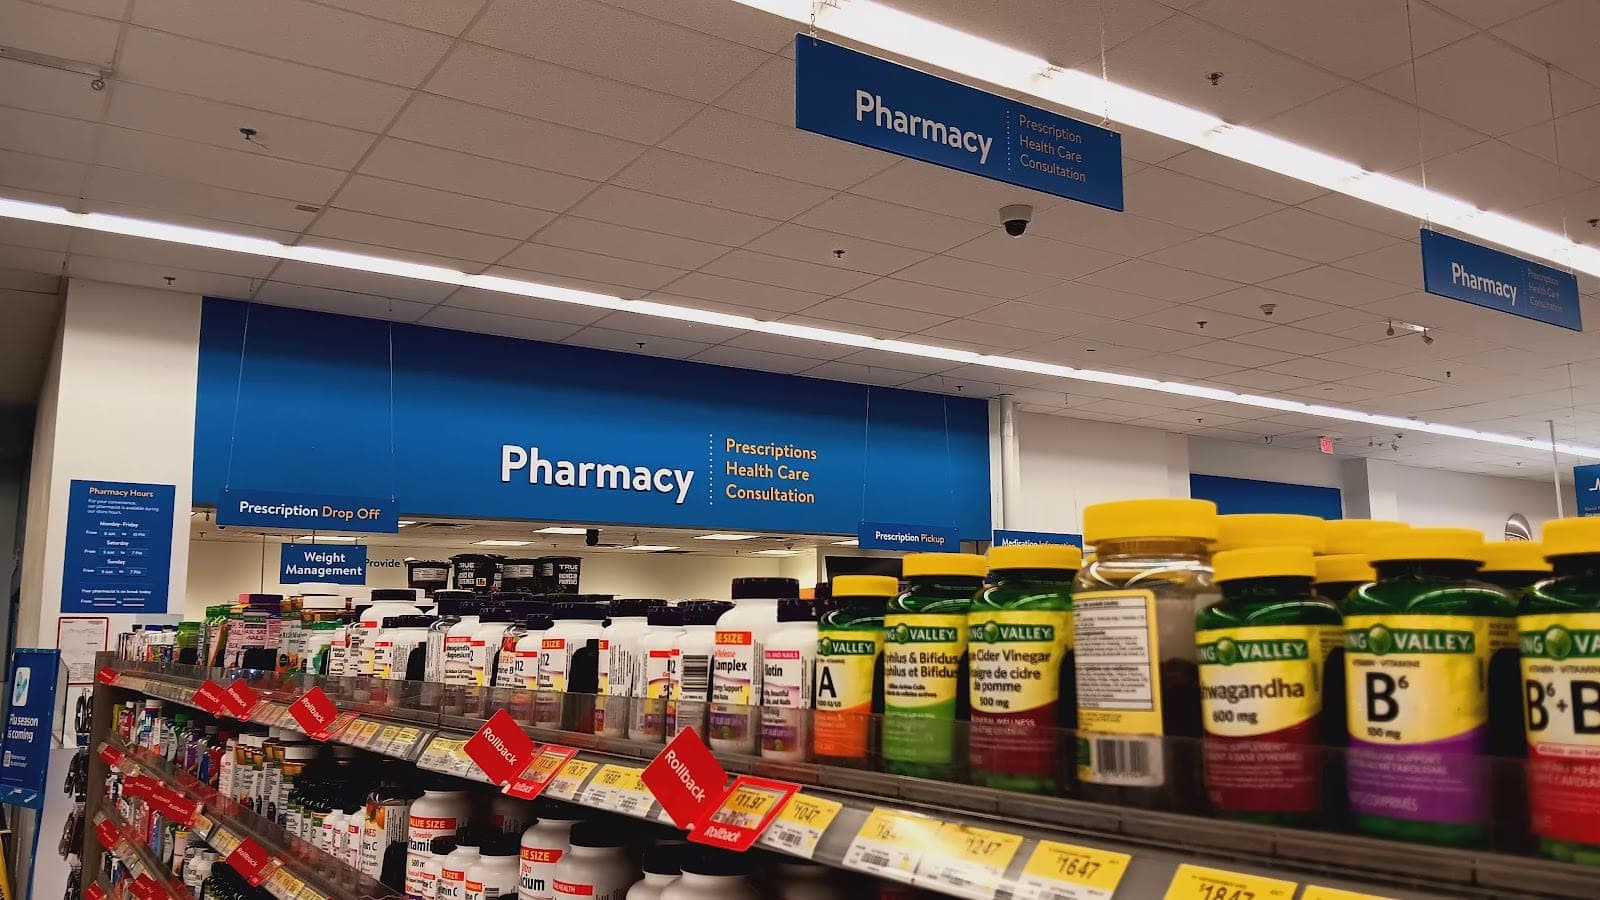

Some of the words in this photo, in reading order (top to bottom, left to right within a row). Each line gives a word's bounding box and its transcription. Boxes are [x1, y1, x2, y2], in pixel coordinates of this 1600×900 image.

[856, 89, 993, 164] Pharmacy
[1019, 114, 1082, 145] Prescription
[1020, 135, 1055, 156] Health
[1057, 145, 1082, 163] Care
[1020, 154, 1086, 183] Consultation
[1451, 262, 1517, 306] Pharmacy
[726, 438, 817, 461] Prescriptions
[501, 444, 695, 504] Pharmacy
[726, 461, 773, 478] Health
[777, 466, 809, 481] Care
[89, 487, 128, 497] Pharmacy
[130, 489, 154, 497] Hours
[726, 484, 815, 504] Consultation
[239, 501, 318, 518] Prescription
[322, 506, 354, 521] Drop
[357, 508, 381, 521] Off
[106, 539, 129, 547] Saturday
[875, 530, 920, 543] Prescription
[920, 533, 945, 546] Pickup
[304, 552, 346, 564] Weight
[365, 558, 401, 568] Provide
[285, 564, 363, 578] Management
[723, 633, 744, 643] SIZE
[909, 629, 953, 641] VALLEY
[999, 627, 1051, 640] VALLEY
[547, 640, 561, 648] SIZE
[832, 641, 872, 654] VALLEY
[1393, 633, 1471, 650] VALLEY
[908, 652, 917, 664] &
[919, 652, 959, 665] Bifidus
[976, 649, 1000, 662] Cider
[1002, 649, 1051, 665] Vinegar
[1238, 643, 1304, 659] VALLEY
[908, 666, 918, 678] et
[993, 667, 1007, 679] de
[1009, 667, 1041, 680] cidre
[723, 684, 743, 693] Support
[818, 666, 837, 698] A
[982, 682, 1022, 693] pomme
[227, 687, 248, 708] Rollback
[979, 696, 994, 706] 500
[995, 698, 1009, 709] mg
[301, 697, 325, 724] Rollback
[1237, 711, 1259, 725] mg
[17, 717, 39, 727] season
[12, 728, 34, 743] coming
[1385, 729, 1402, 741] mg
[482, 727, 518, 766] Rollback
[664, 749, 706, 804] Rollback
[425, 819, 446, 829] SIZE
[703, 825, 742, 843] Rollback
[236, 846, 259, 869] Rollback
[530, 850, 550, 862] SIZE
